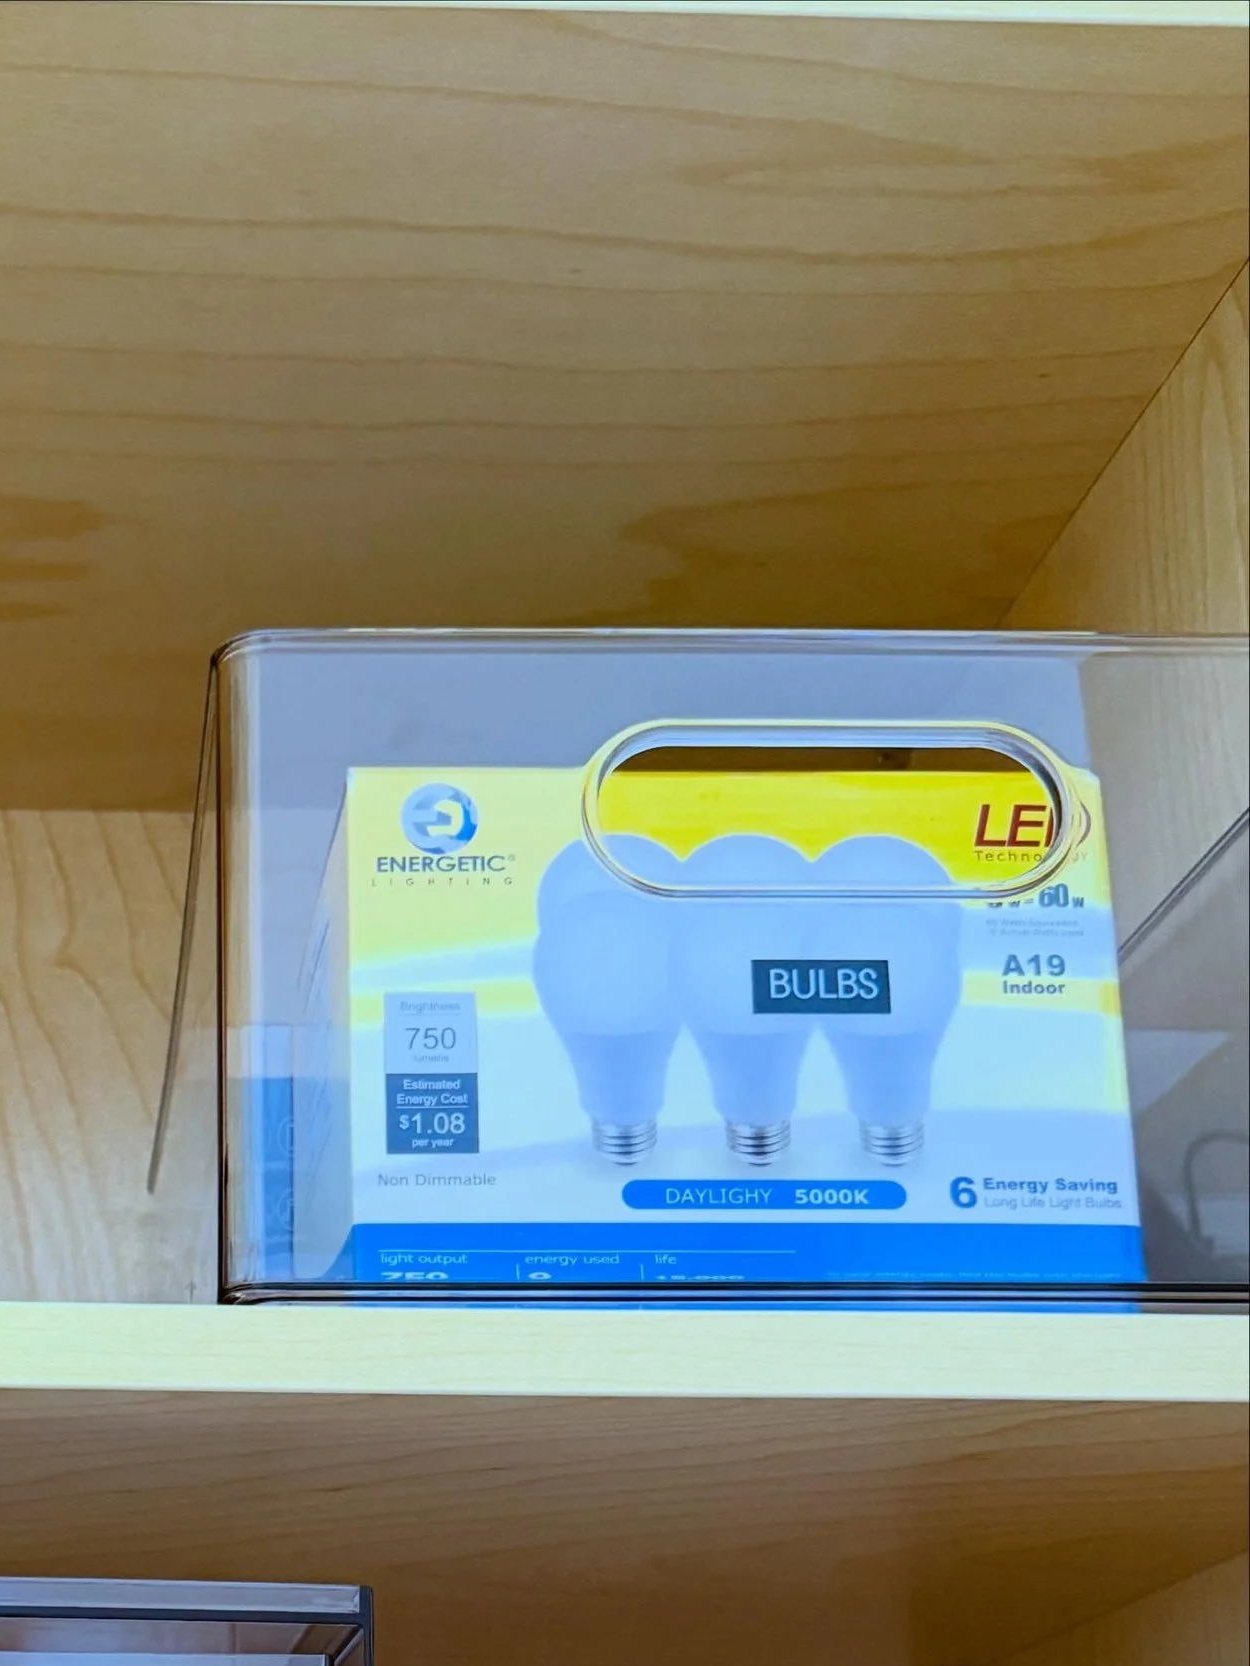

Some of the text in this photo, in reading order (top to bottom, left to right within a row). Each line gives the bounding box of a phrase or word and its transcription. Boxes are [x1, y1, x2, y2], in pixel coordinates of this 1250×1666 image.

[371, 877, 513, 887] LIGHTING
[1002, 953, 1066, 977] A19
[768, 967, 879, 1000] BULBS
[1002, 980, 1066, 995] Indoor
[405, 1027, 457, 1050] 750
[402, 1078, 461, 1091] Estimated
[396, 1093, 469, 1107] Energy Cost
[399, 1112, 466, 1135] $1.08
[411, 1138, 455, 1149] per year
[377, 1173, 497, 1187] Non Dimmable
[982, 1178, 1118, 1194] Energy Saving
[794, 1188, 870, 1205] 5000K
[949, 1176, 978, 1209] 6
[380, 1252, 468, 1266] light output
[525, 1253, 620, 1267] energy used
[655, 1253, 678, 1265] life
